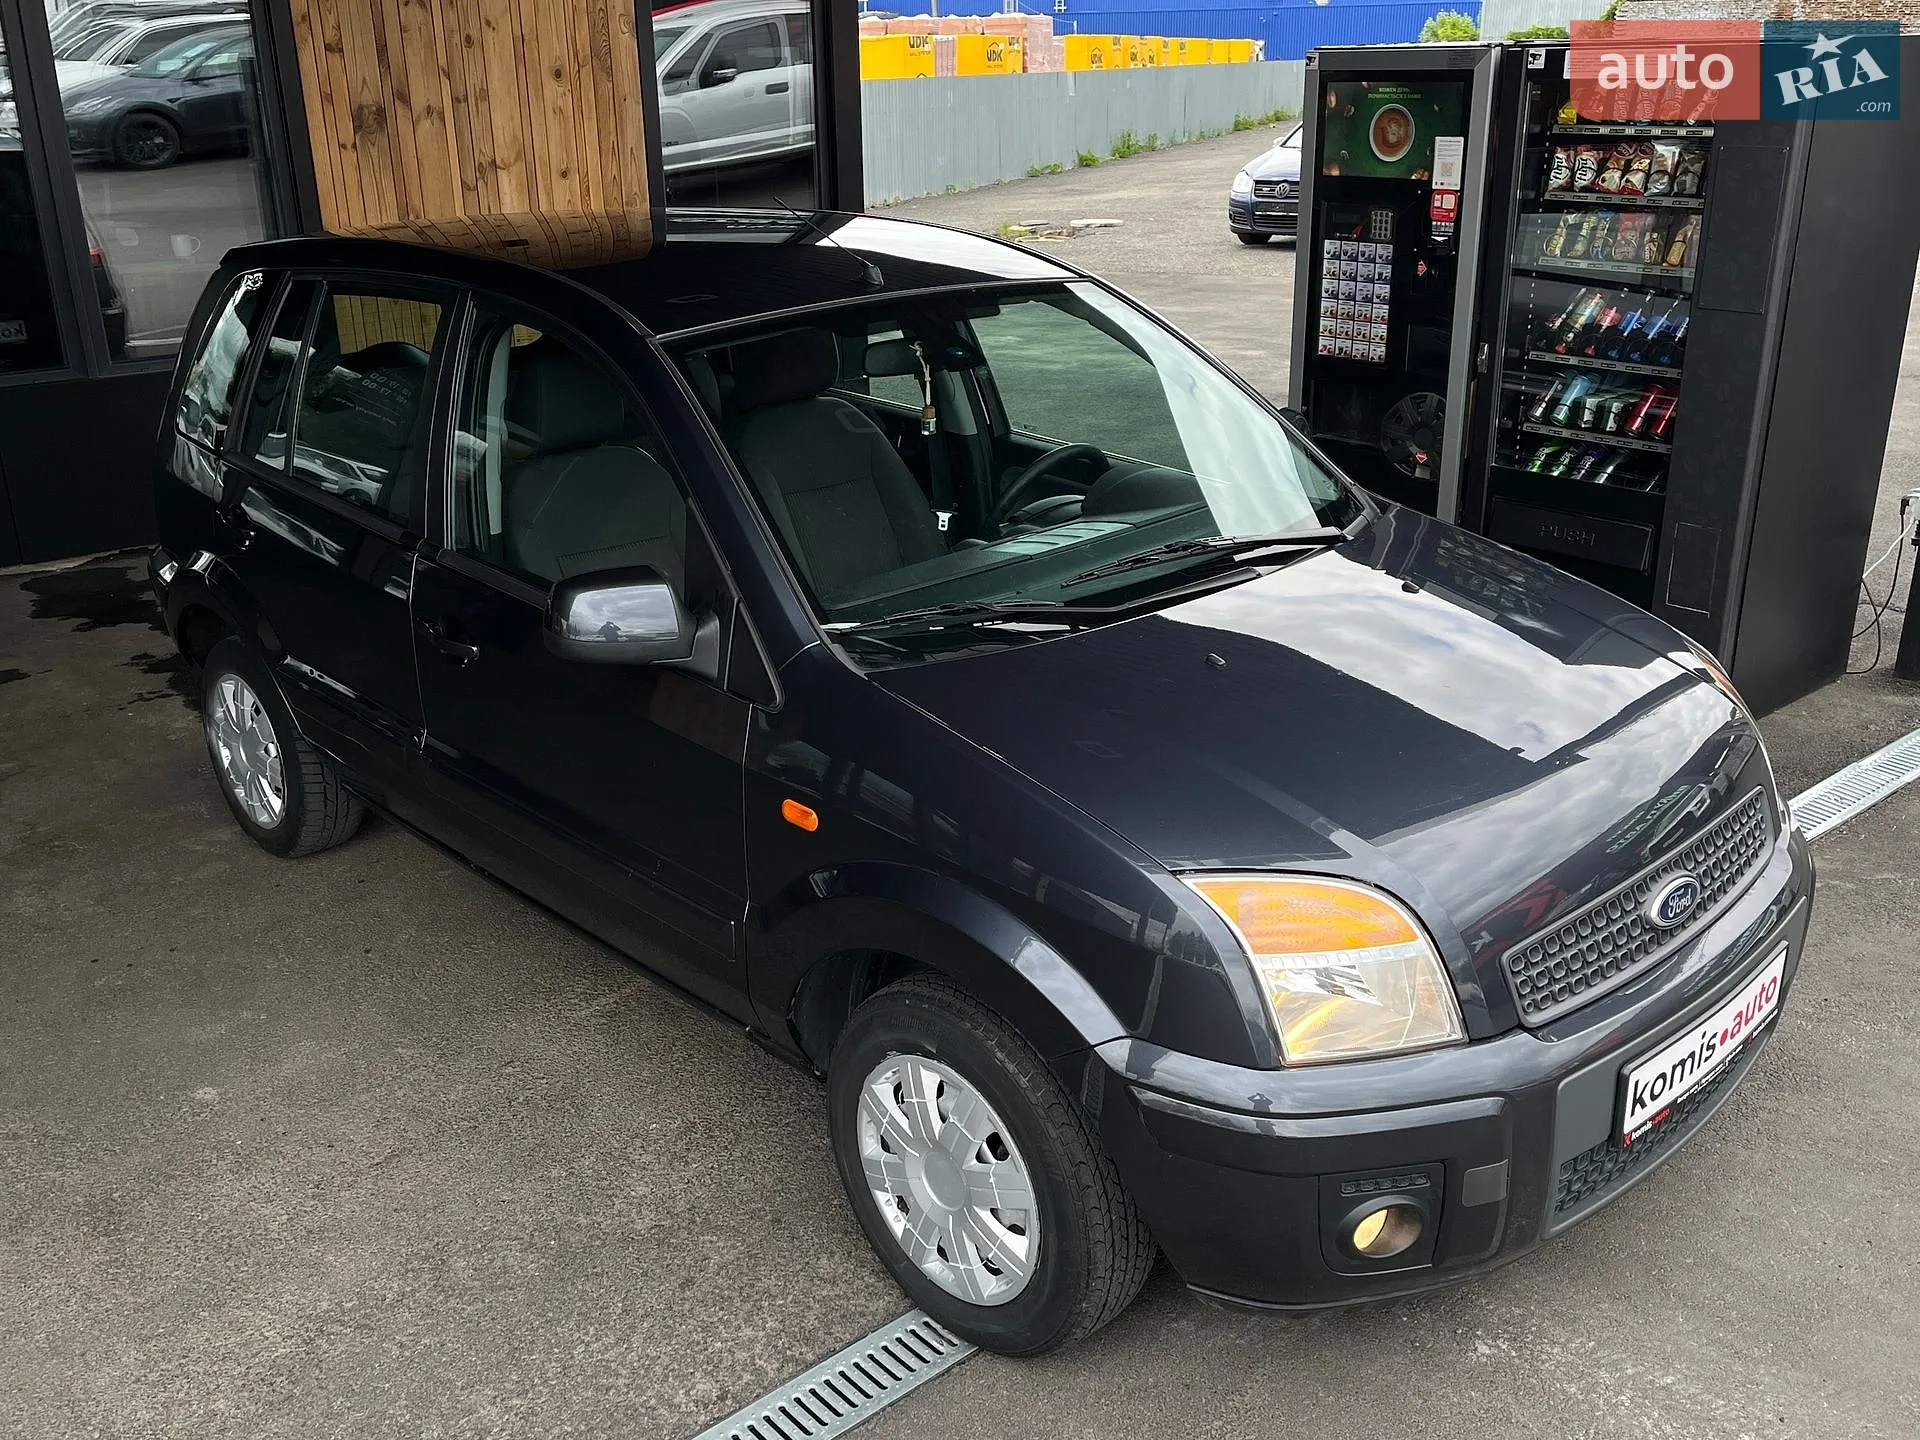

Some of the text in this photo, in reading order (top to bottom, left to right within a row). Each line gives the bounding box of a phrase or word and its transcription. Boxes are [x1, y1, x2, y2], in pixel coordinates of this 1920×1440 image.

[909, 36, 928, 48] UDK
[986, 49, 1003, 62] UDK
[1668, 887, 1693, 918] Ford
